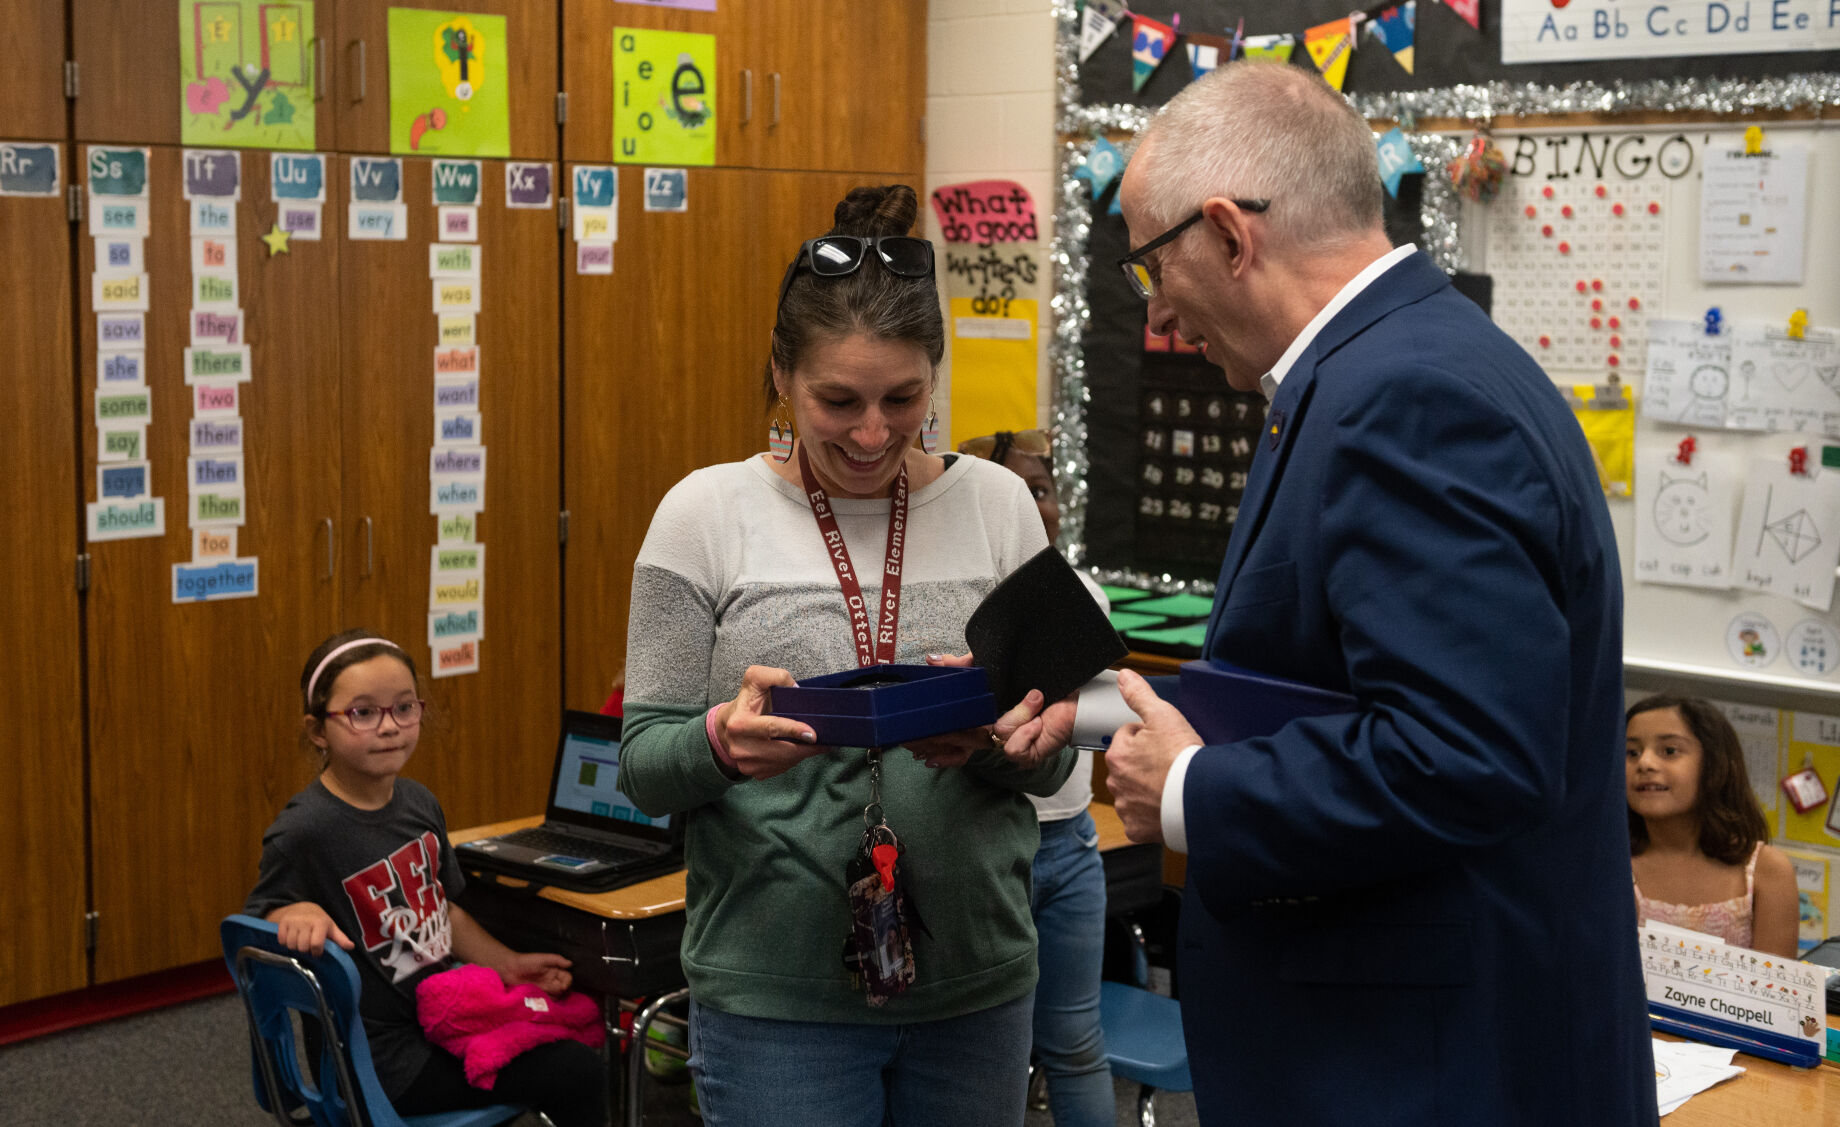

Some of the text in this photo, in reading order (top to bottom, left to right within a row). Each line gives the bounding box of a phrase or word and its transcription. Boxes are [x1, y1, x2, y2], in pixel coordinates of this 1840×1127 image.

[1537, 12, 1578, 42] Aa
[1593, 8, 1629, 39] Bb
[1647, 5, 1687, 36] Cc
[1706, 2, 1749, 33] Dd
[1771, 0, 1810, 31] Ee
[620, 35, 635, 52] a
[638, 60, 653, 80] e
[624, 81, 629, 107] i
[672, 63, 705, 120] e
[638, 112, 653, 131] o
[622, 138, 636, 156] u
[0, 148, 33, 175] Rr
[90, 151, 123, 179] Ss
[190, 155, 216, 181] Tt
[1380, 142, 1404, 174] R
[278, 158, 307, 184] Uu
[354, 161, 382, 187] Vv
[438, 163, 473, 188] Ww
[510, 167, 536, 191] Xx
[580, 169, 602, 196] Yy
[650, 171, 672, 195] Zz
[933, 188, 1027, 215] What
[104, 209, 135, 223] see
[201, 207, 228, 224] the
[287, 211, 315, 228] use
[358, 214, 392, 236] very
[447, 216, 469, 231] we
[583, 218, 607, 236] you
[943, 214, 1038, 249] do good
[109, 247, 130, 262] so
[204, 241, 225, 262] to
[438, 251, 471, 270] with
[581, 250, 609, 269] your
[103, 277, 139, 297] said
[201, 279, 233, 298] this
[441, 287, 471, 302] was
[972, 286, 1015, 317] do?
[103, 322, 140, 337] saw
[197, 315, 238, 343] they
[104, 358, 138, 378] she
[193, 353, 241, 371] there
[437, 353, 476, 371] what
[200, 388, 234, 407] two
[438, 386, 476, 404] want
[100, 400, 148, 415] some
[1235, 403, 1248, 420] 7
[196, 423, 238, 443] their
[442, 418, 473, 437] who
[107, 436, 139, 457] say
[435, 452, 480, 471] where
[197, 463, 236, 481] then
[437, 484, 477, 503] when
[200, 497, 239, 515] than
[1226, 506, 1239, 523] 2
[98, 505, 155, 528] should
[886, 467, 908, 577] Elementary
[442, 516, 472, 540] why
[202, 535, 229, 552] too
[438, 553, 477, 568] were
[177, 567, 254, 599] together
[810, 489, 871, 666] Eel River Otters
[436, 580, 478, 599] would
[434, 612, 477, 635] which
[879, 589, 897, 644] River
[440, 644, 474, 666] walk
[1664, 986, 1775, 1026] Zayne Chappell
